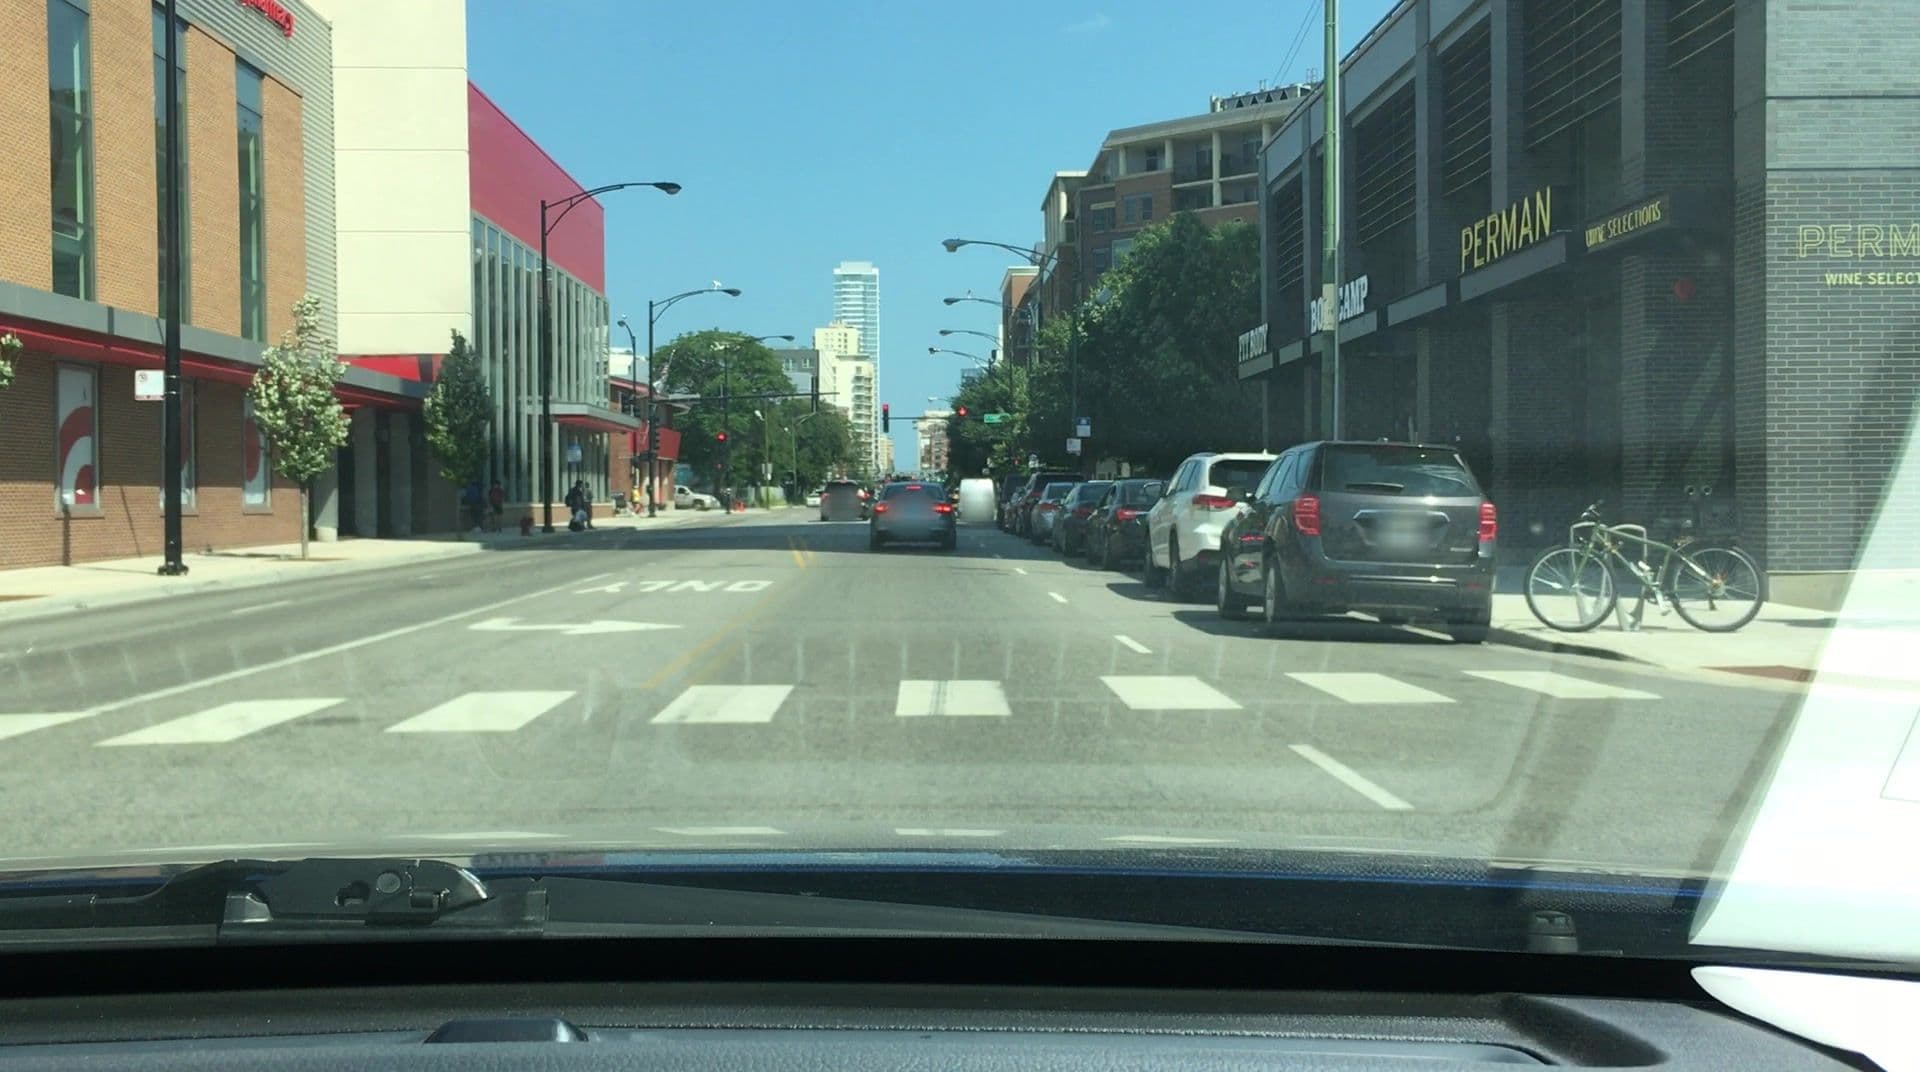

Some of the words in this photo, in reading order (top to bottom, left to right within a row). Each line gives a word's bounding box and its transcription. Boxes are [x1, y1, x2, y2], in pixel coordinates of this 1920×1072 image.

[1461, 186, 1551, 276] PERMAN
[1585, 223, 1606, 248] WINE
[1607, 200, 1662, 239] SELECTIONS
[1799, 223, 1920, 258] PERM
[1825, 272, 1863, 286] WINE
